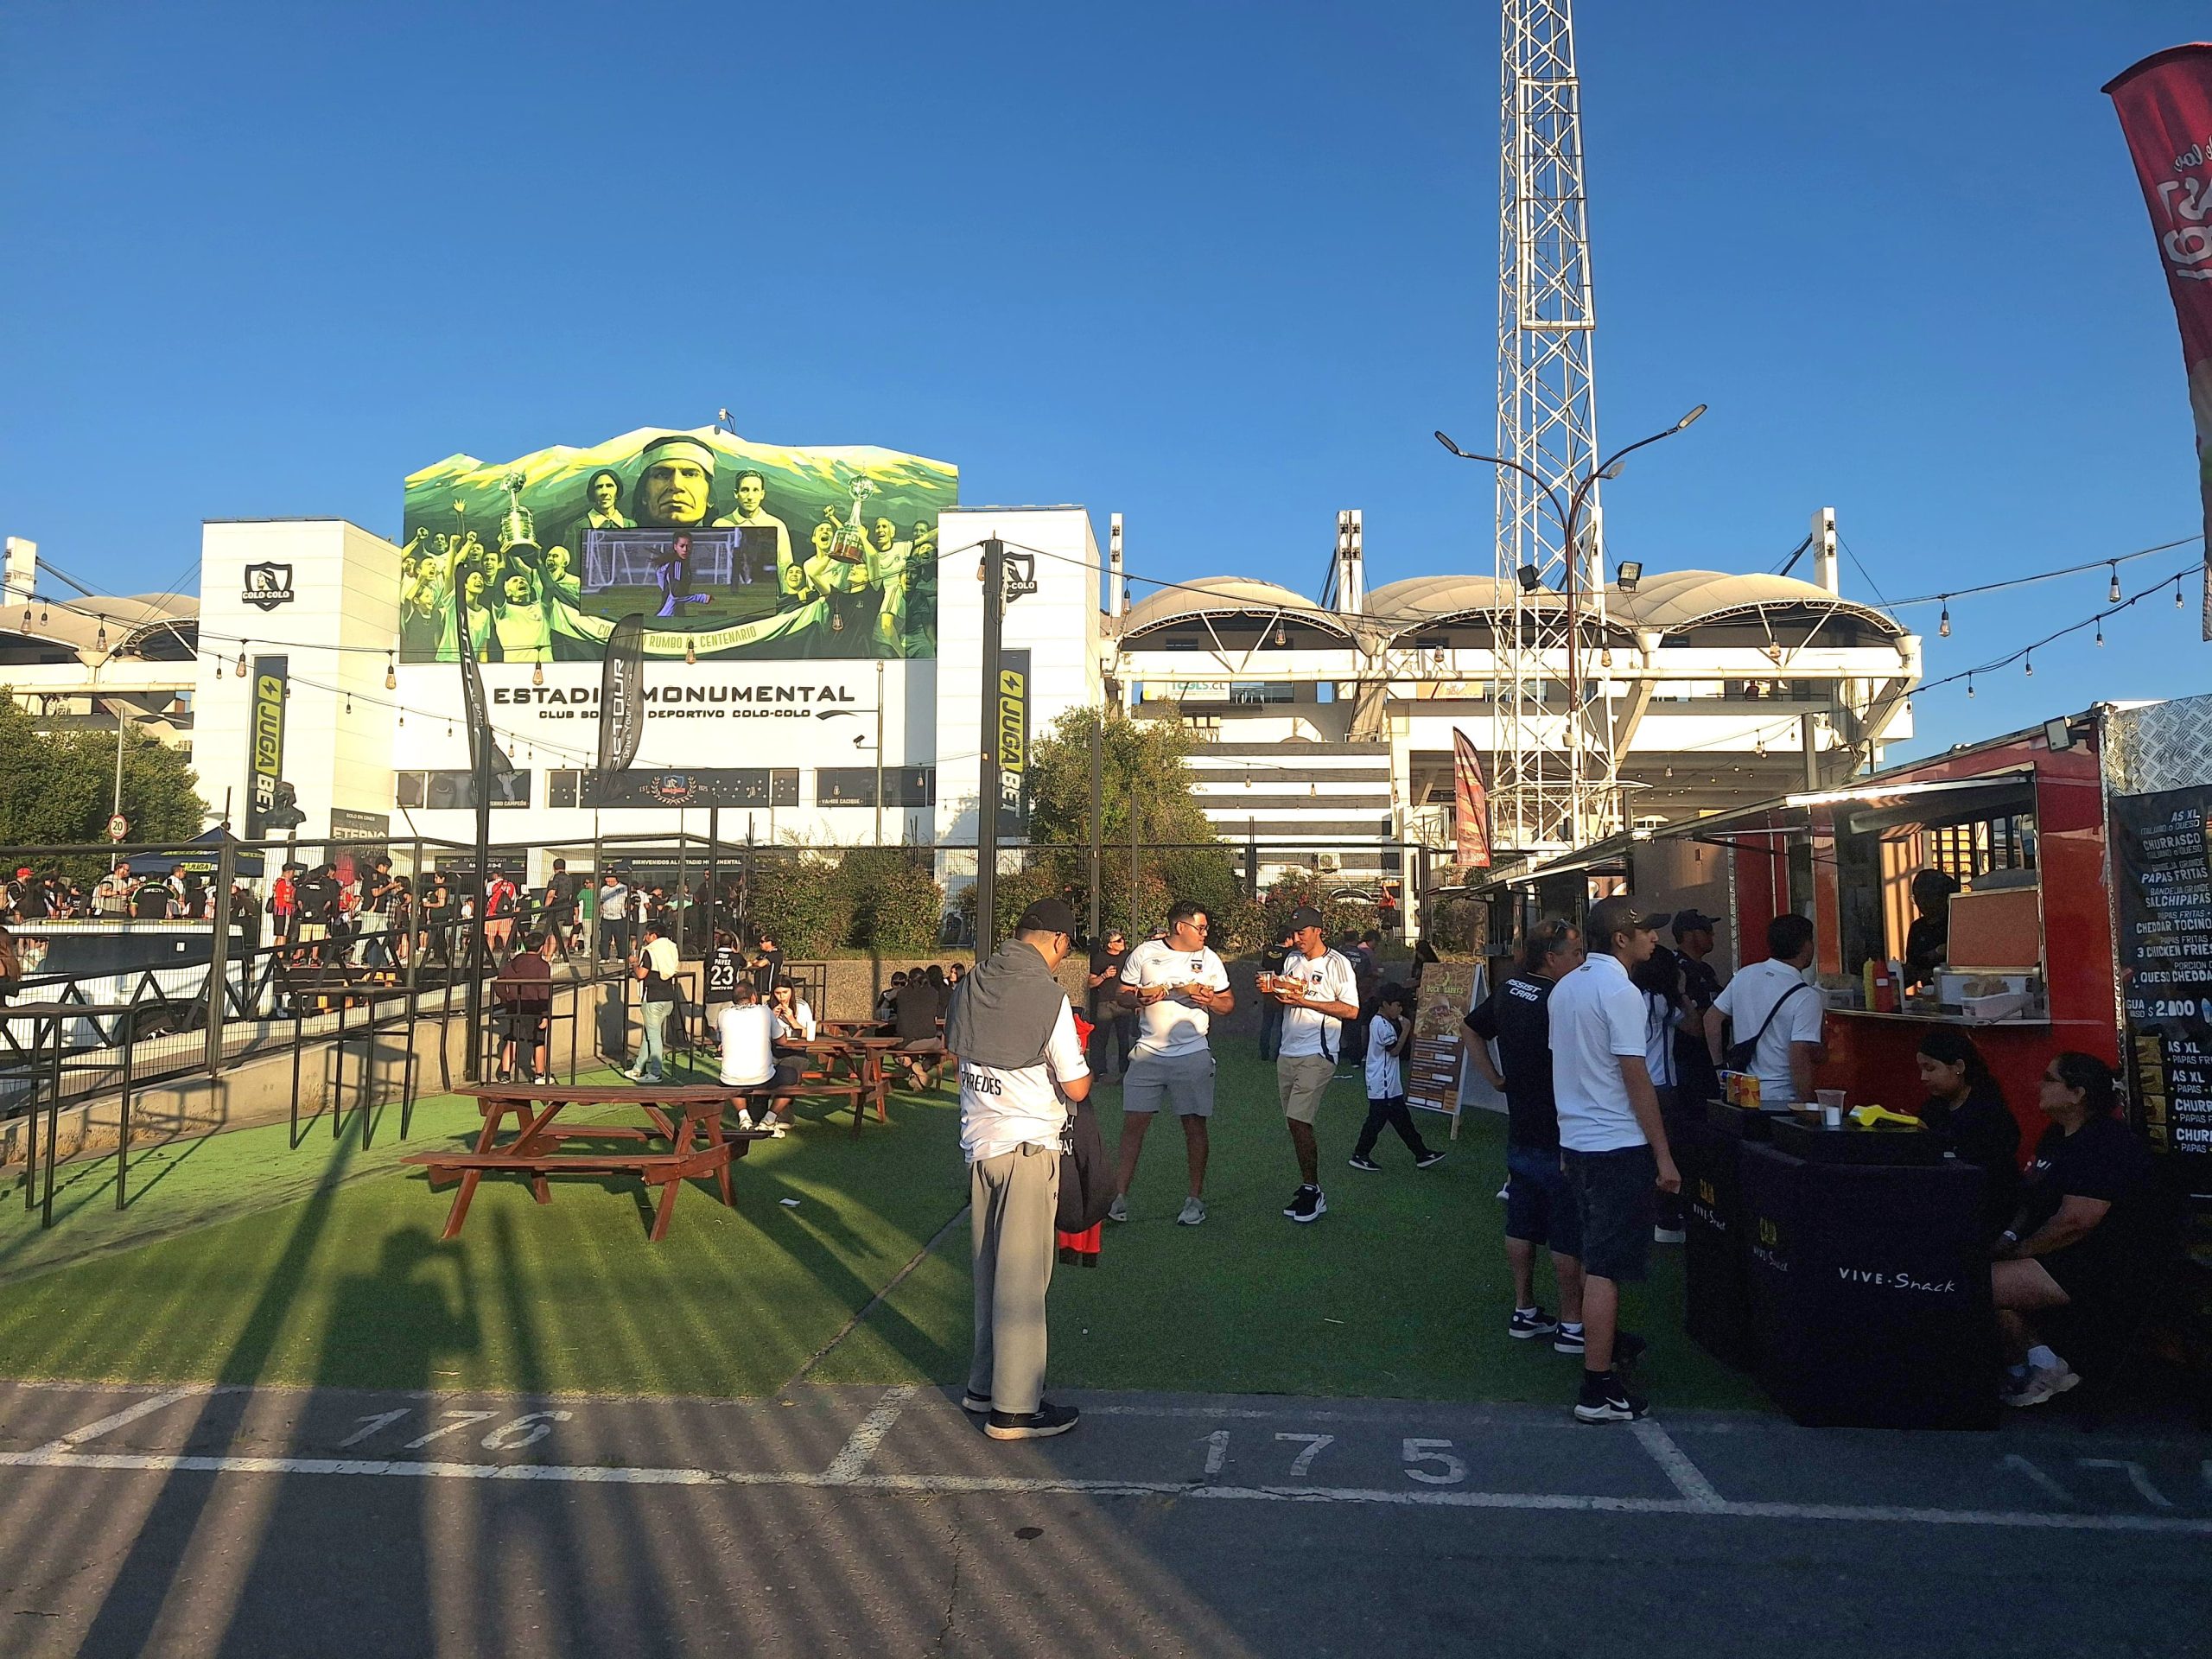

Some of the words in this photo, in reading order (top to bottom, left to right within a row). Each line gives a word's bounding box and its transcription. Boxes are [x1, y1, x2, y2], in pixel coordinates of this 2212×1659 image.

[649, 635, 683, 649] RUMBO
[700, 626, 757, 647] CENTENARIO
[493, 687, 599, 704] ESTADI
[642, 685, 855, 702] MONUMENTAL
[538, 710, 575, 719] CLUB
[648, 709, 725, 719] DEPORTIVO
[732, 709, 810, 718] COLO-COLO
[623, 734, 632, 759] Drive
[2171, 810, 2184, 823] AS
[2187, 808, 2201, 820] XL
[112, 820, 123, 831] 20
[2143, 832, 2201, 851] CHURRASCO
[2141, 870, 2173, 884] PAPAS
[2173, 866, 2209, 881] FRITAS
[2150, 886, 2183, 896] BANDEJA
[2145, 892, 2212, 908] SALCHIPAPAS
[2179, 909, 2205, 918] FRITAS
[2136, 919, 2172, 934] CHEDDAR
[2174, 917, 2212, 931] TOCINO
[2181, 934, 2209, 944] FRITAS
[2136, 946, 2145, 958] 3
[2146, 944, 2182, 958] CHICKEN
[2174, 960, 2207, 970] PORCION
[710, 965, 734, 985] 23
[2140, 970, 2171, 983] QUESO
[1505, 978, 1542, 993] ASSIST
[1509, 987, 1539, 1001] CARD
[2167, 1040, 2181, 1053] AS
[2183, 1041, 2201, 1054] XL
[2172, 1054, 2197, 1065] PAPAS
[961, 1071, 1001, 1096] PAREDES
[2172, 1069, 2187, 1083] AS
[2190, 1071, 2206, 1084] XL
[2177, 1084, 2202, 1094] PAPAS
[2179, 1113, 2206, 1123] PAPAS
[2181, 1142, 2207, 1154] PAPAS
[339, 1408, 574, 1451] 176
[2002, 1453, 2212, 1508] 17
